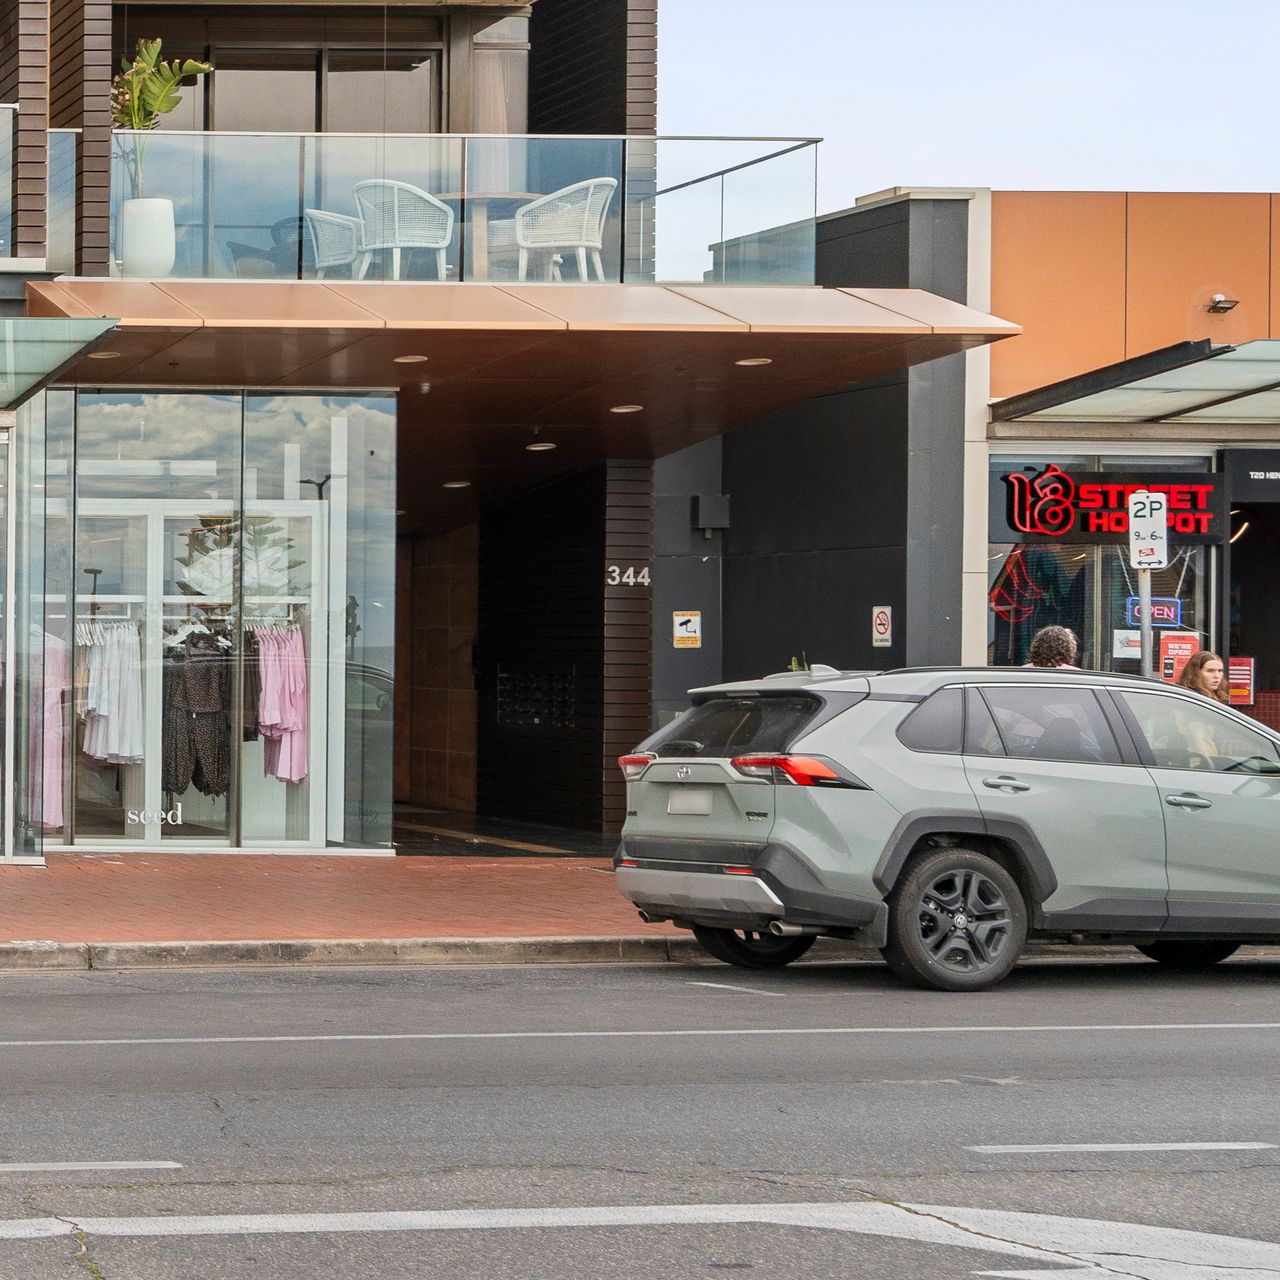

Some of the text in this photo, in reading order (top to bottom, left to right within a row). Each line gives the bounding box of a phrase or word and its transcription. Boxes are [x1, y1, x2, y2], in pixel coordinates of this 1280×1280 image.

[1133, 500, 1163, 518] 2P
[1089, 511, 1214, 534] HOOT
[607, 565, 651, 586] 344
[1134, 605, 1175, 619] OEN
[127, 802, 184, 825] seed
